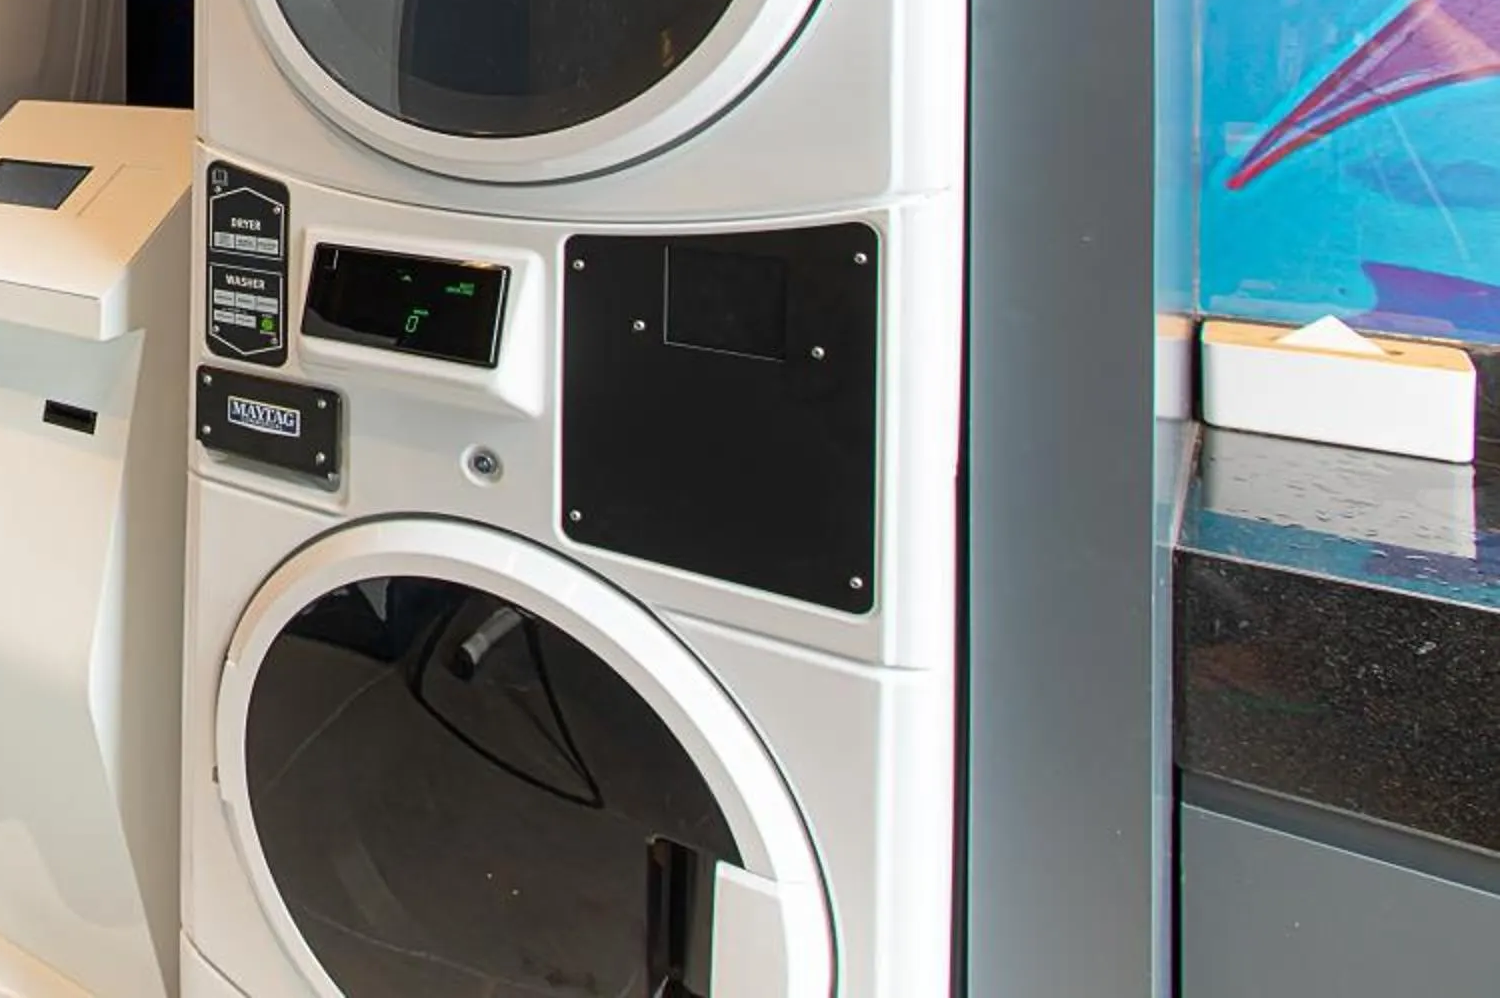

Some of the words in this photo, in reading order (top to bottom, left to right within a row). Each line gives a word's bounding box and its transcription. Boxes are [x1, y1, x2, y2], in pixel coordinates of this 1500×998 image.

[231, 217, 261, 231] DRYER
[225, 273, 265, 290] WASHER
[231, 401, 296, 427] MAYTAG
